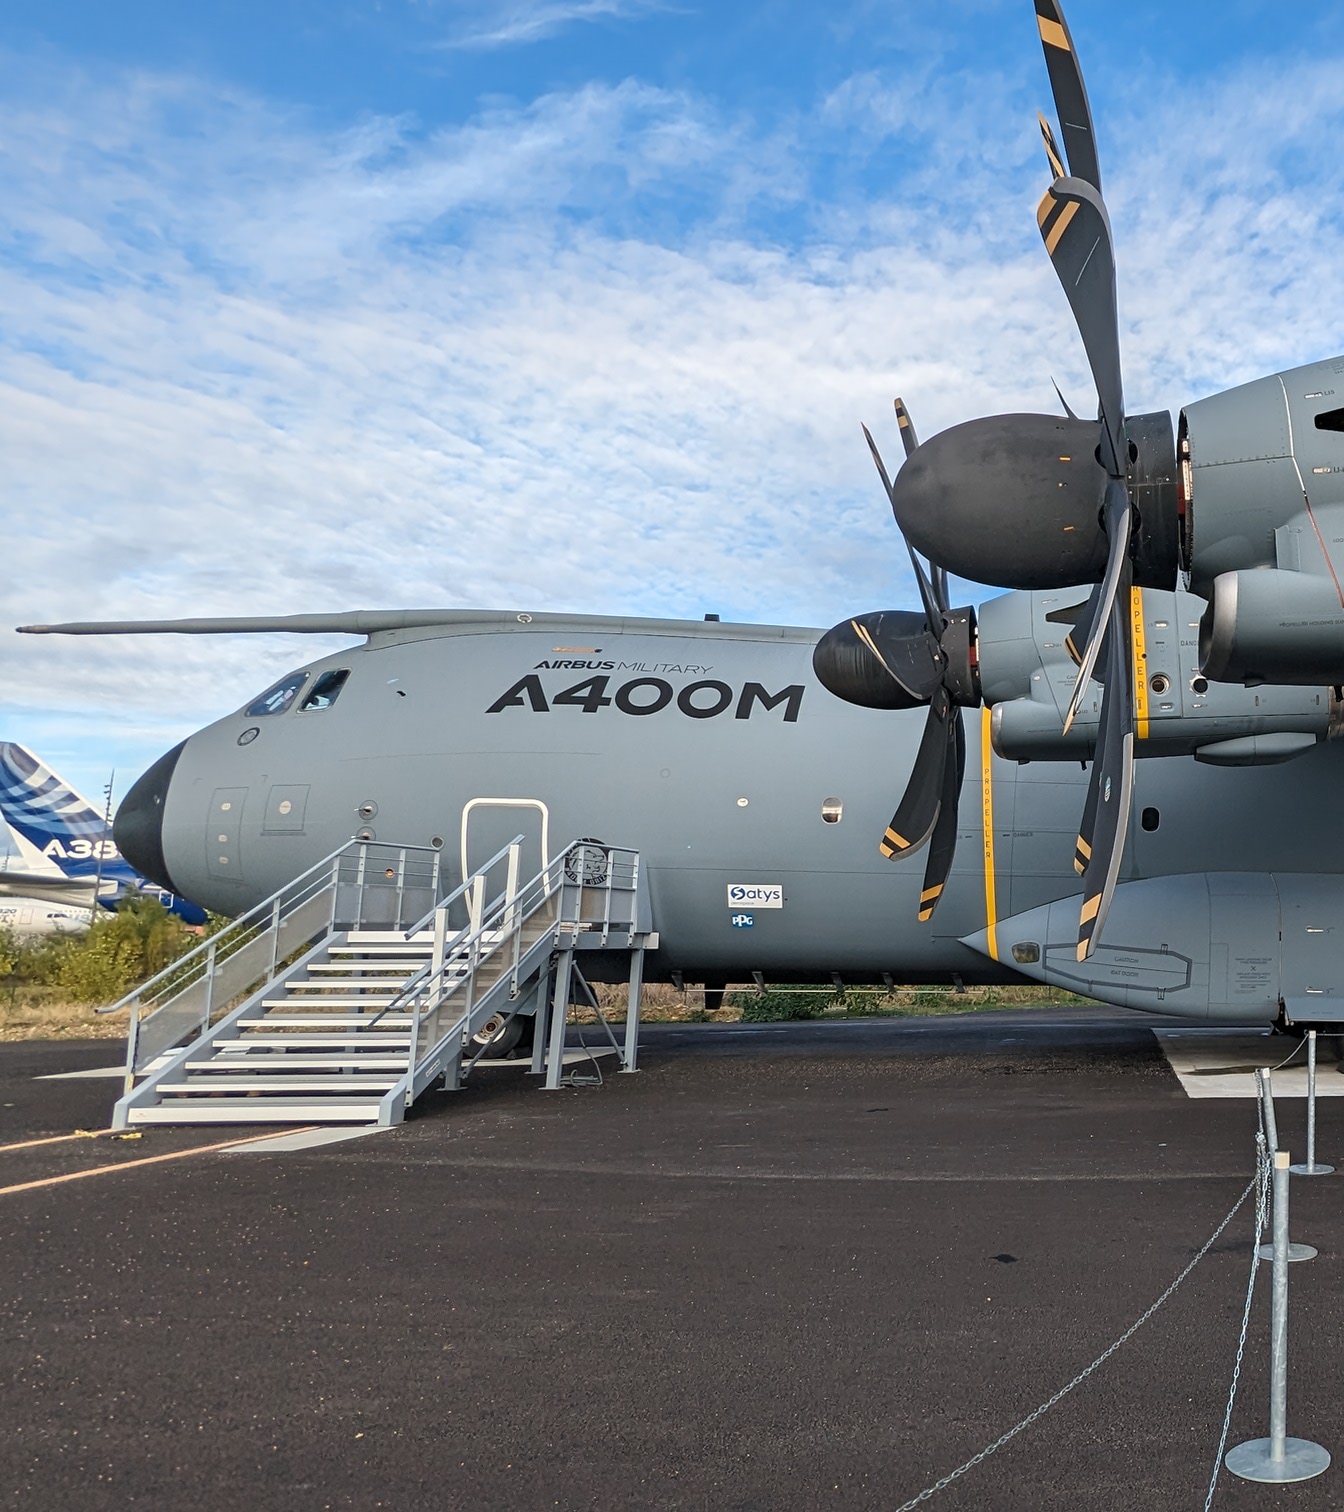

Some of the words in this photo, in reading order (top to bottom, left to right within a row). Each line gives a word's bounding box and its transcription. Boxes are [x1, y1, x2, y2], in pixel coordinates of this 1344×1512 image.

[1132, 586, 1144, 690] ROPELLER
[533, 660, 616, 670] AIRBUS
[617, 661, 714, 675] MILITARY
[484, 674, 806, 723] A400M
[42, 839, 121, 859] A38
[730, 886, 780, 902] Satys
[732, 914, 753, 927] PPG
